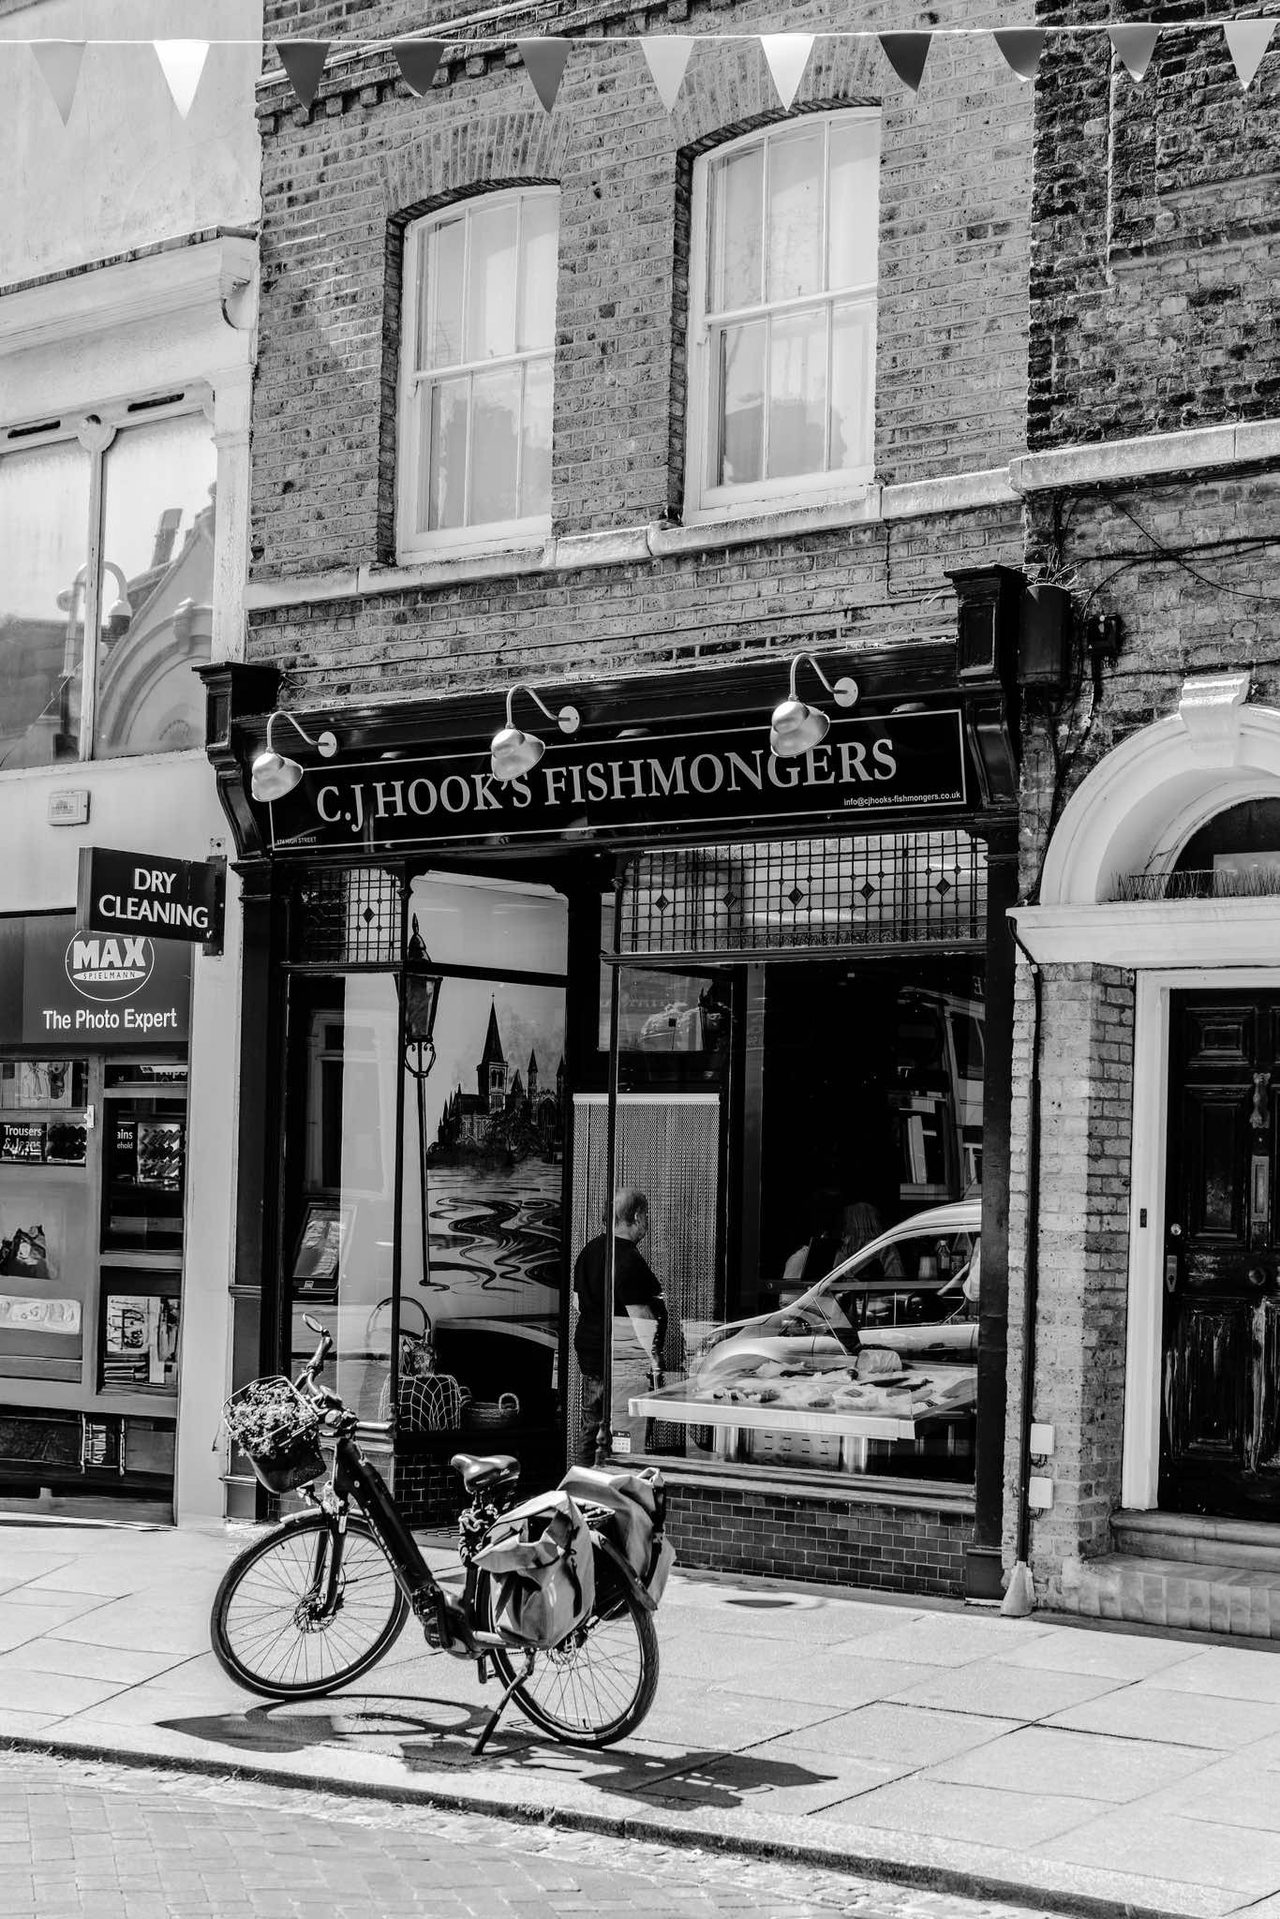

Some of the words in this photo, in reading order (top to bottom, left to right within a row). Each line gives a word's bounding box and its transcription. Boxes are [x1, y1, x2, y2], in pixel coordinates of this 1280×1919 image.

[373, 772, 532, 819] HOOK'S
[542, 738, 897, 806] FISHMONGERS
[134, 868, 177, 894] DRY
[98, 895, 209, 928] CLEANING
[73, 938, 146, 969] MAX
[83, 971, 136, 980] SPIELMANN
[43, 1010, 71, 1029] The
[75, 1009, 119, 1029] Photo
[124, 1008, 177, 1032] Expert
[4, 1124, 42, 1136] Trousers
